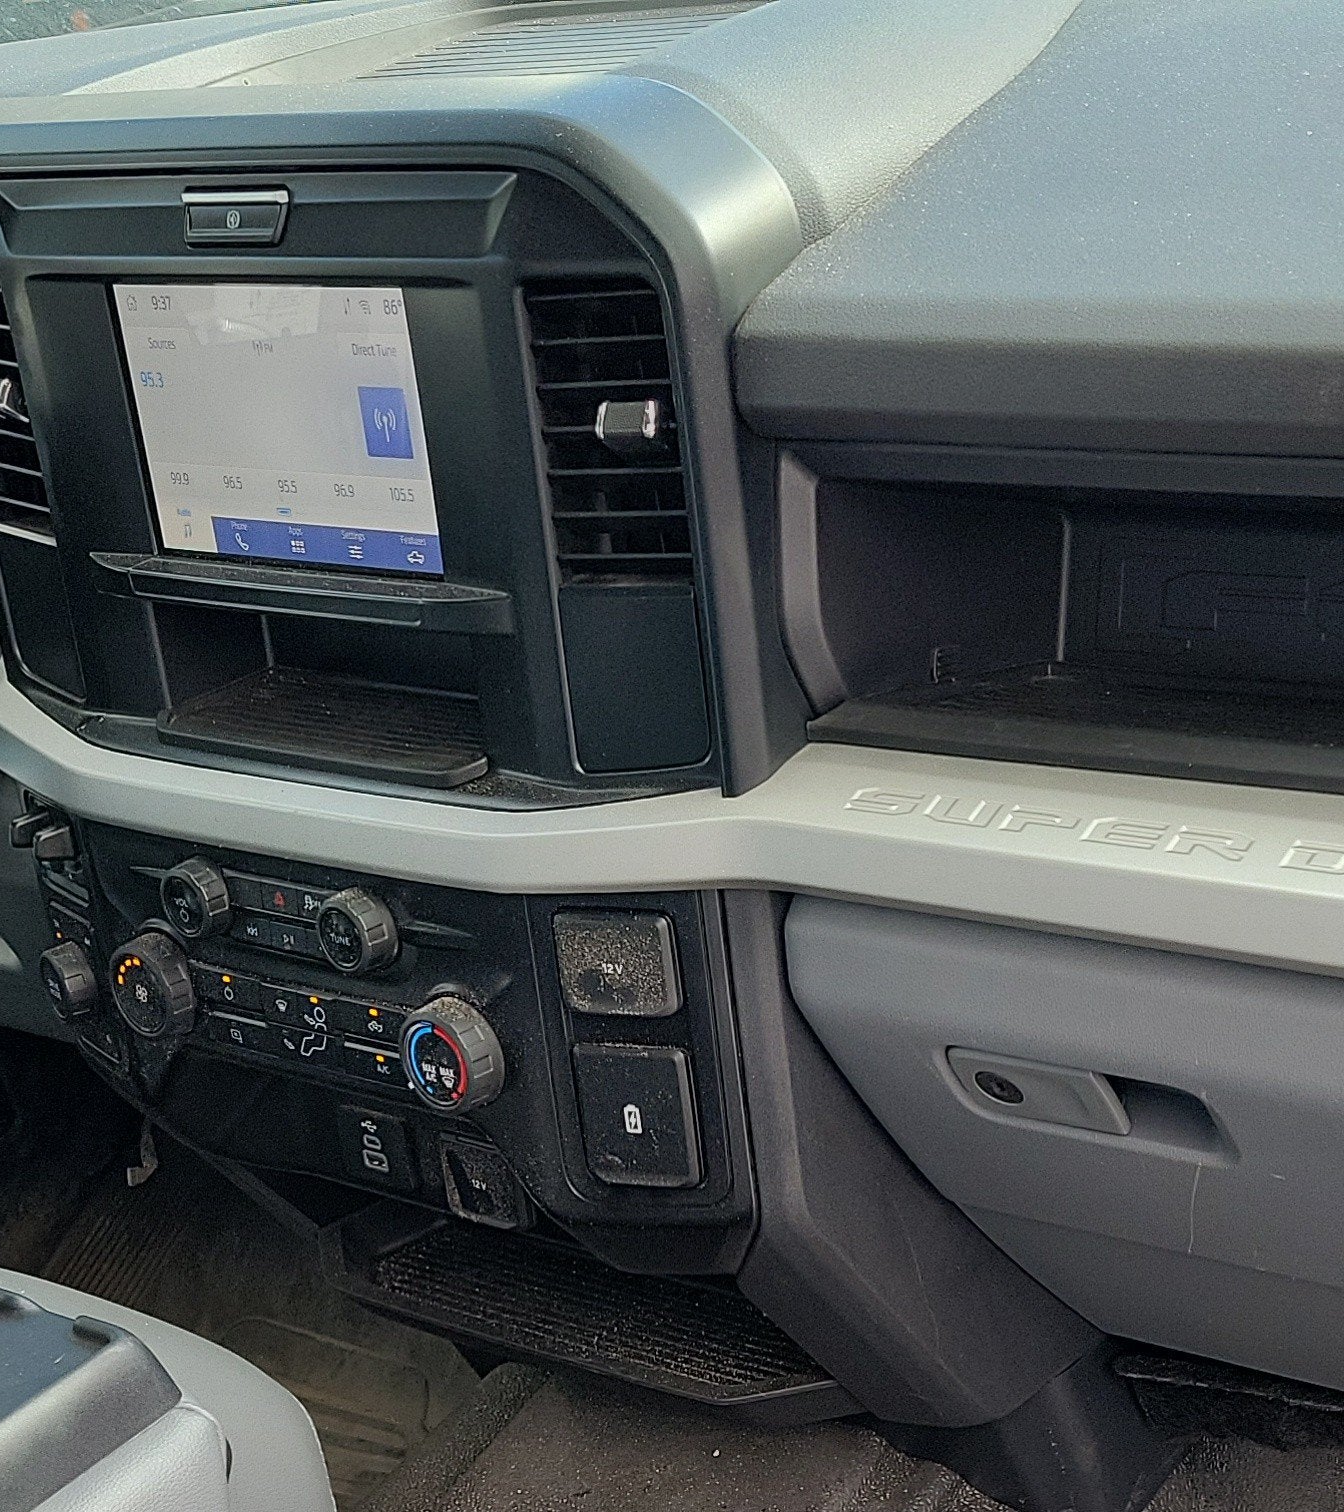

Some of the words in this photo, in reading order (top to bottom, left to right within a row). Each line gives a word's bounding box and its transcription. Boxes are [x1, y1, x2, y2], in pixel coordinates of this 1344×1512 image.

[151, 295, 171, 311] 9:37
[148, 337, 176, 351] Sources
[351, 343, 375, 357] Direct
[376, 344, 397, 358] Tune
[140, 371, 164, 389] 95.3
[170, 471, 190, 486] 99.9
[222, 475, 243, 490] 96.5
[277, 479, 297, 494] 95.5
[333, 483, 355, 498] 96.9
[389, 487, 414, 502] 105.5
[843, 785, 1254, 862] SUPER
[329, 932, 351, 947] TUNE
